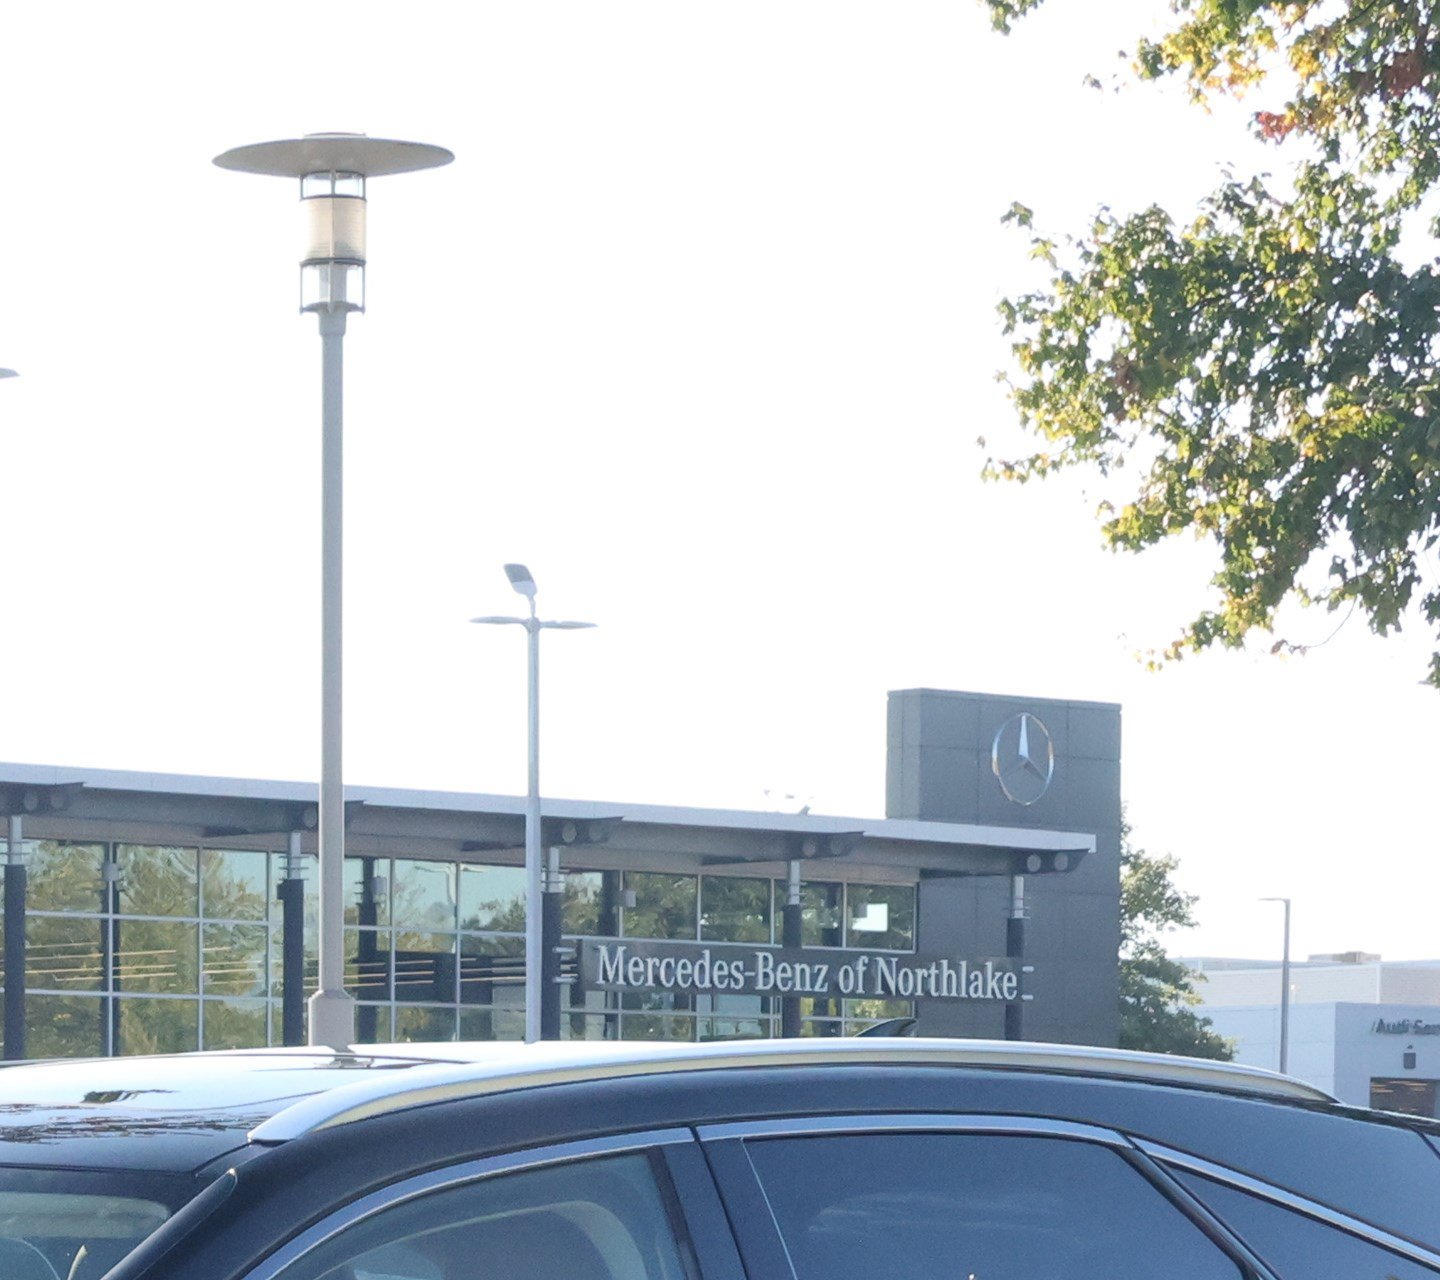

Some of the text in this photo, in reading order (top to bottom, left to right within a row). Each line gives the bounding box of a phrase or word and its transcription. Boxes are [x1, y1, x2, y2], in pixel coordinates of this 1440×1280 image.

[595, 944, 1018, 1001] Mercedes-Benz of Northlake
